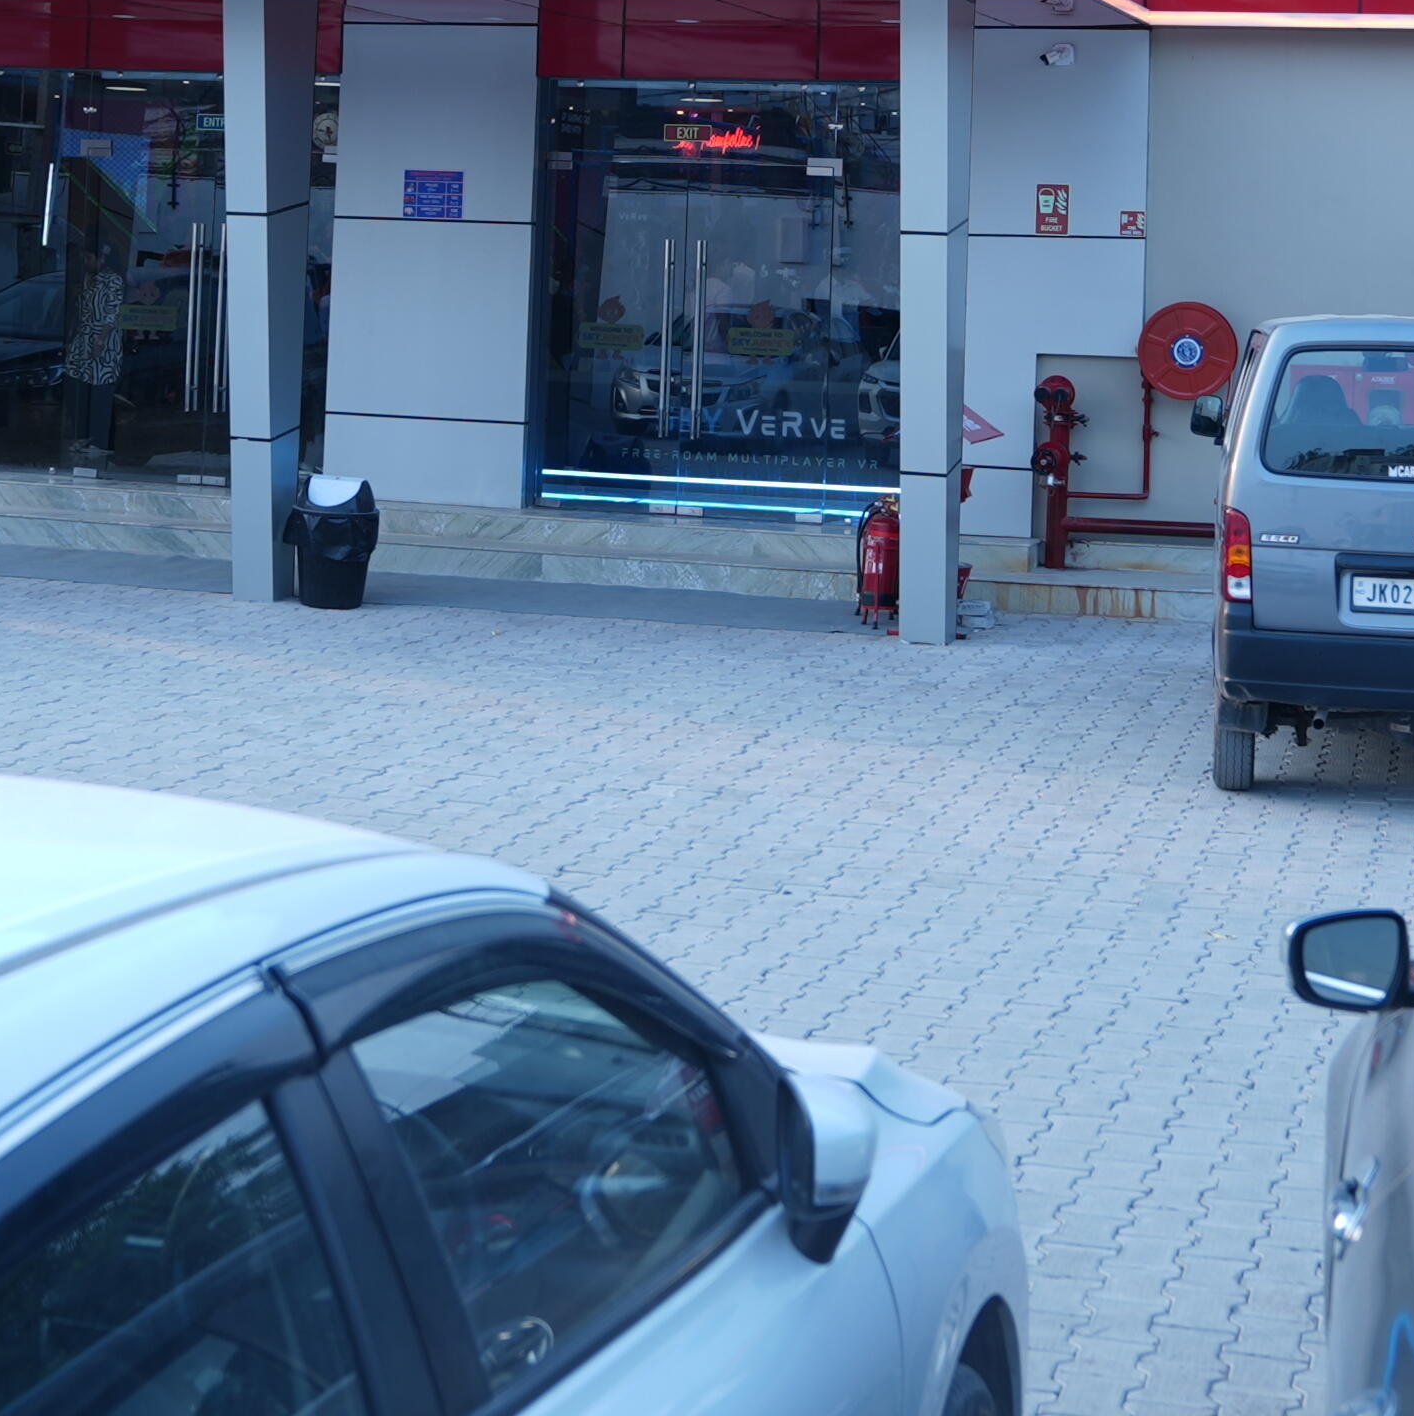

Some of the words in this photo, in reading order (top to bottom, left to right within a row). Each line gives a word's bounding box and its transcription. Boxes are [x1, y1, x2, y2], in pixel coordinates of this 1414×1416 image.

[676, 126, 700, 140] EXIT
[1045, 216, 1059, 224] FIRE
[1040, 224, 1063, 232] BUCKET
[621, 446, 718, 463] FREE-ROAM
[727, 452, 846, 469] MULTIPLAYER
[857, 458, 879, 470] VR
